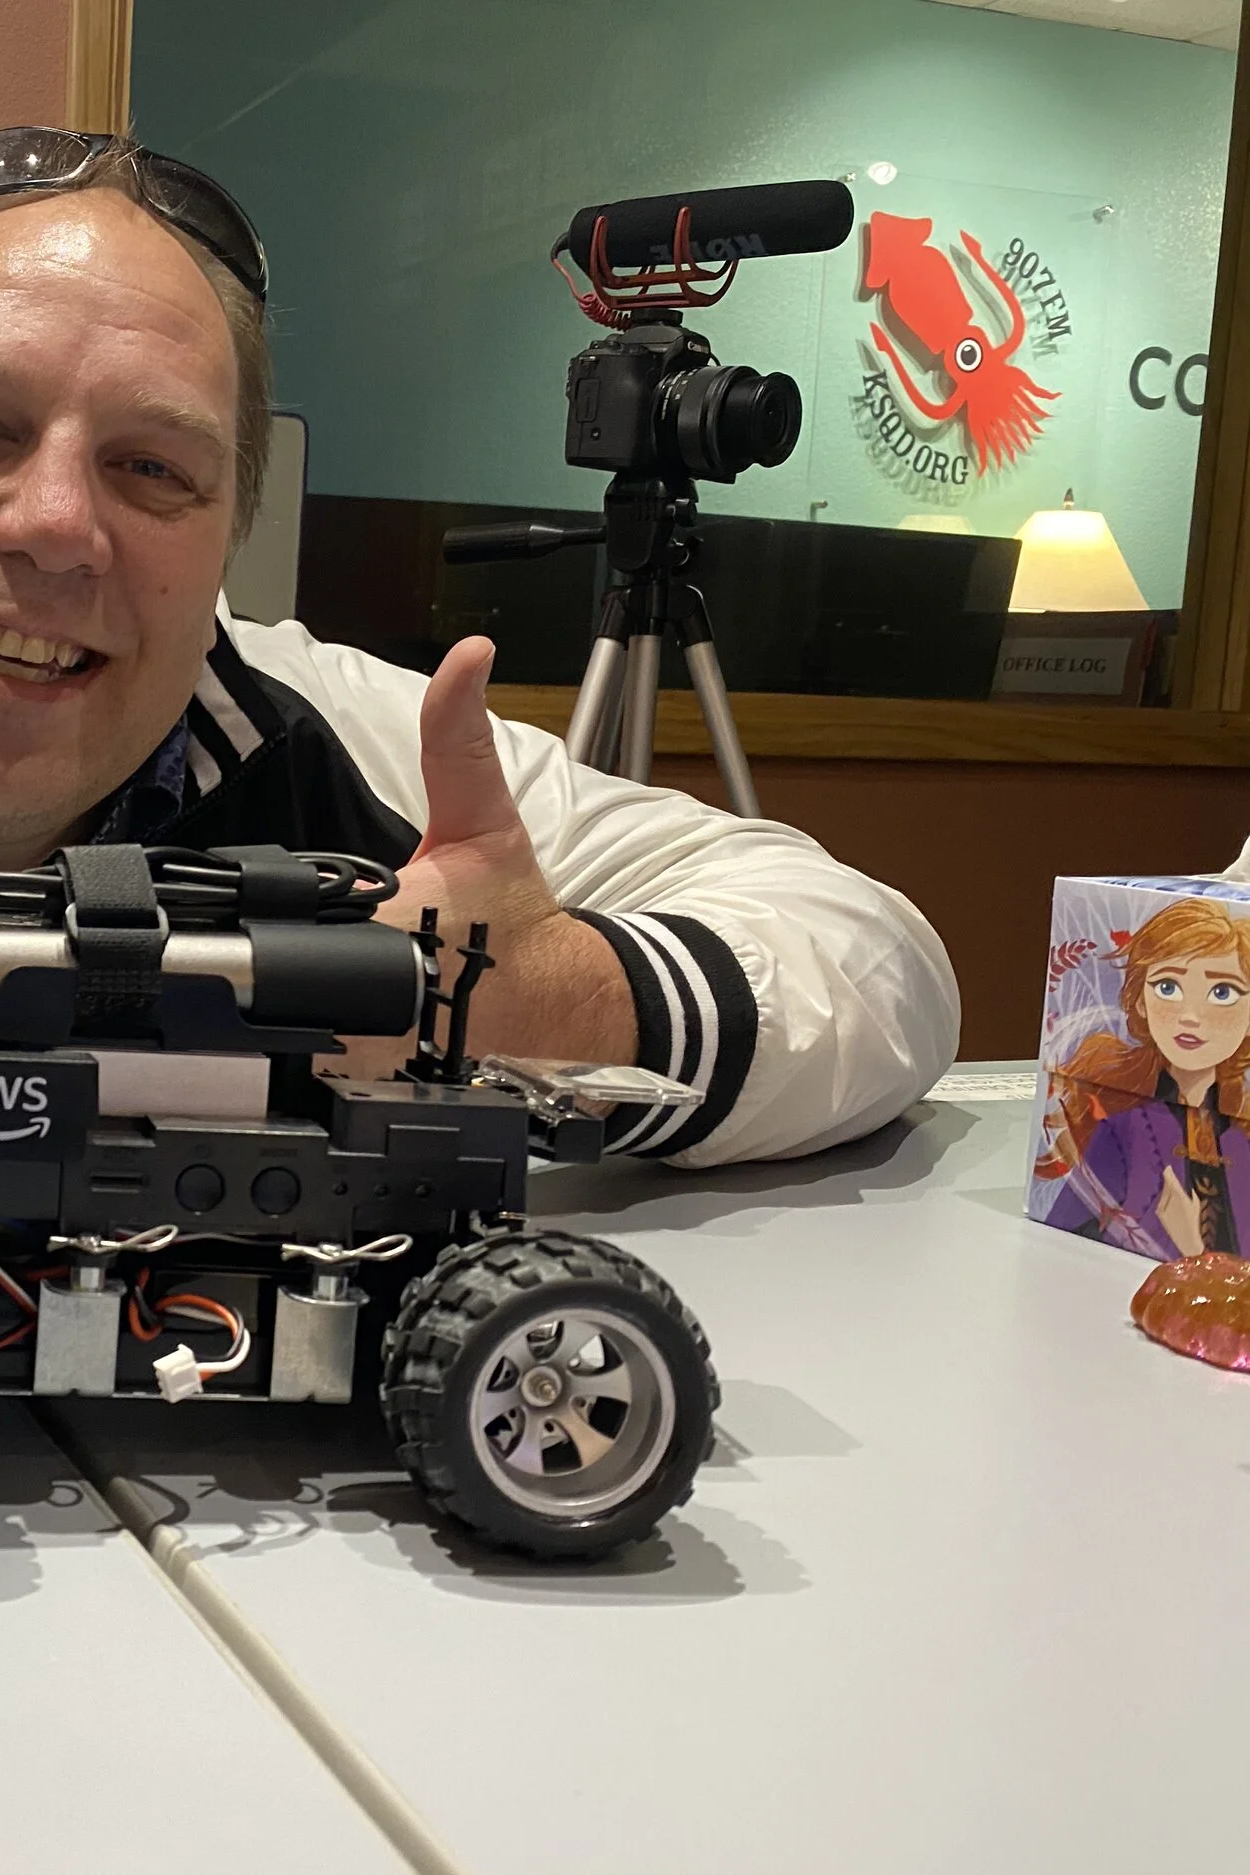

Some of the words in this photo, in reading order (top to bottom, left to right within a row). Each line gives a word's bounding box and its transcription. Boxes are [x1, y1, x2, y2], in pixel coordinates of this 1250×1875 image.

[863, 368, 970, 485] KSQD.ORG
[1003, 657, 1066, 672] OFFICE
[1068, 658, 1108, 673] LOG
